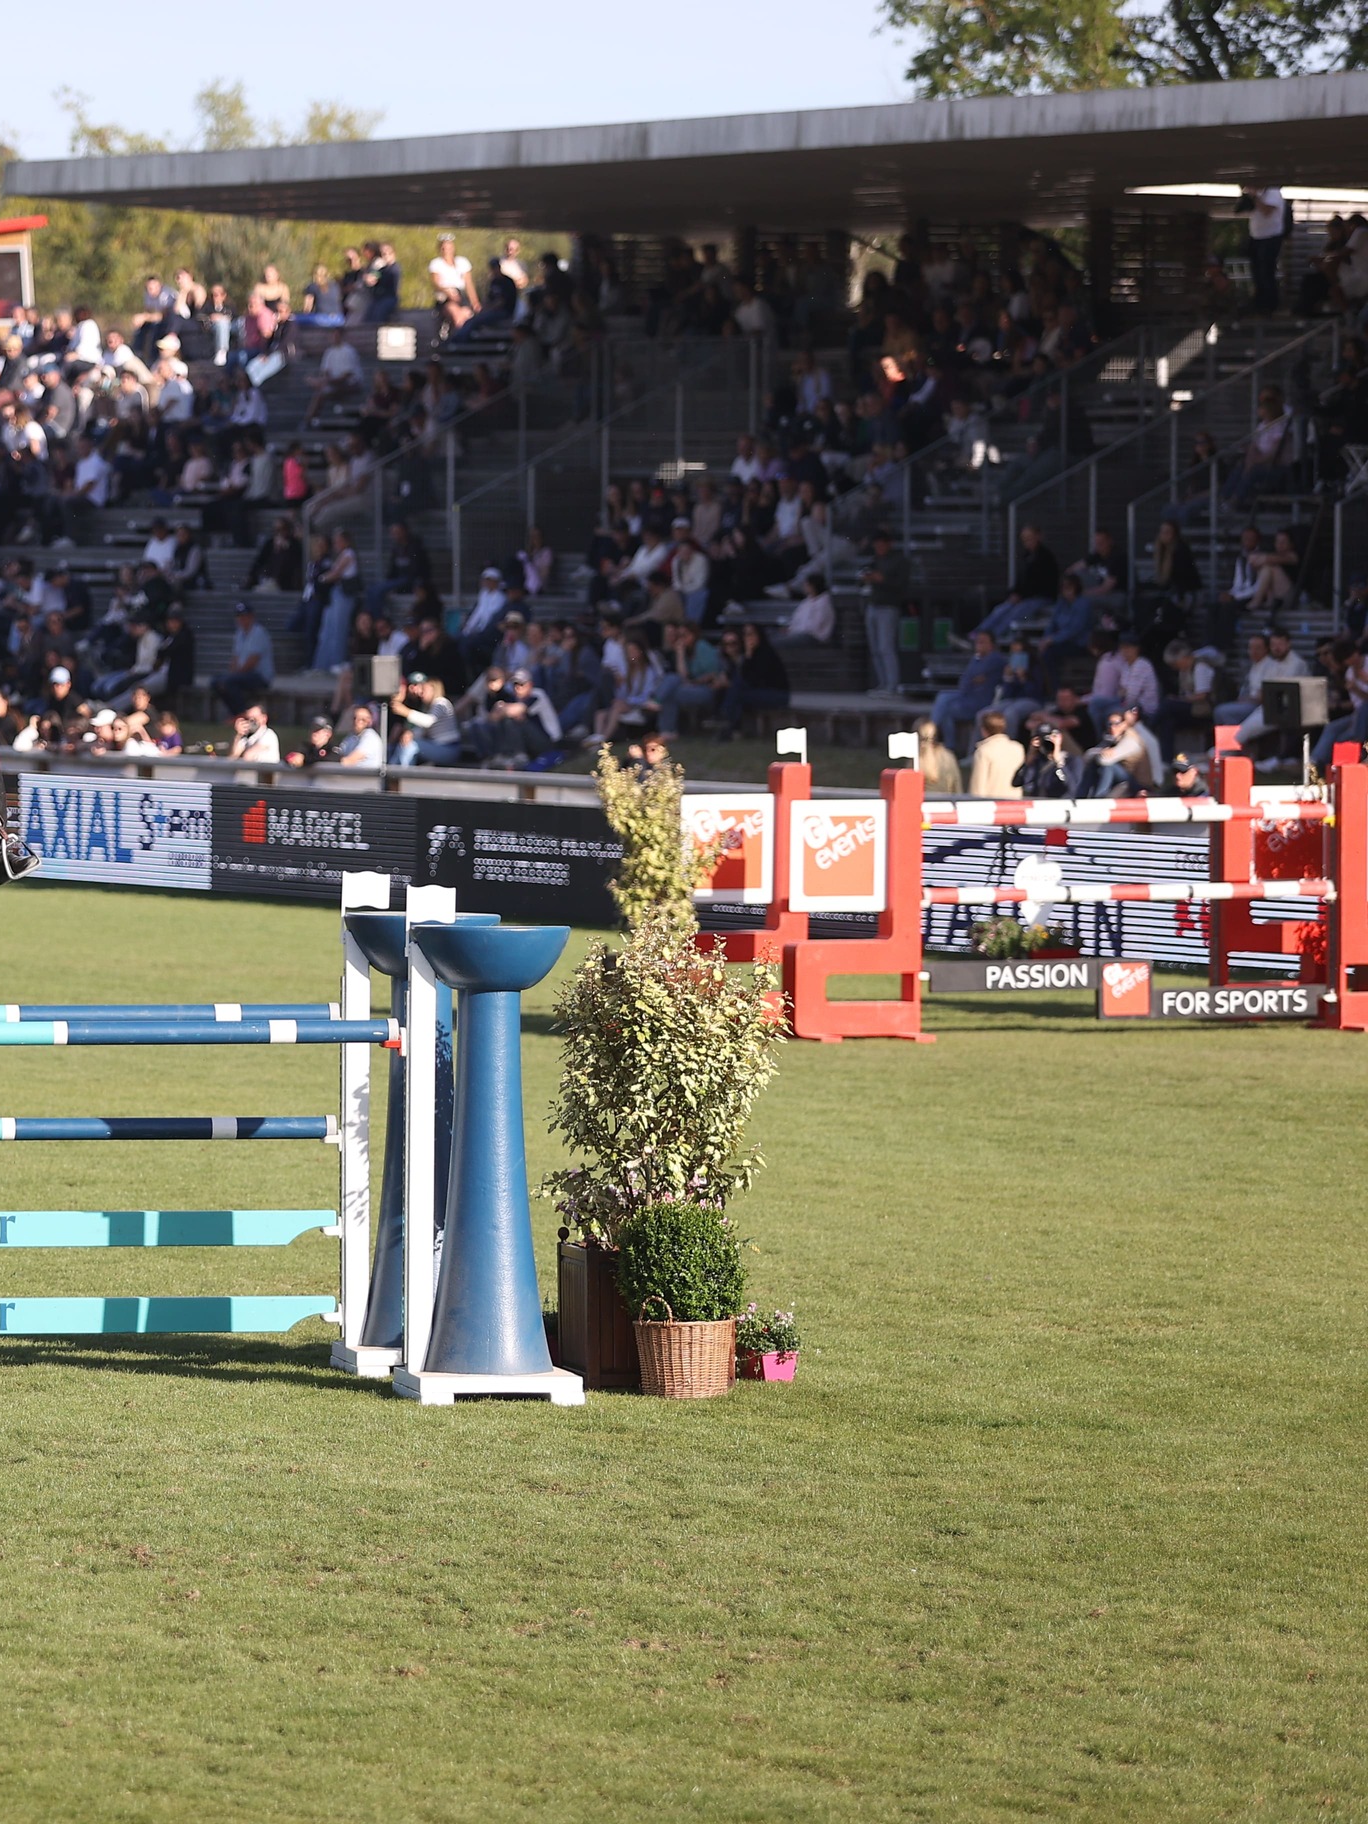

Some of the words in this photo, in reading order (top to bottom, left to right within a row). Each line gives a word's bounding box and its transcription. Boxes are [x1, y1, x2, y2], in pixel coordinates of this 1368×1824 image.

[24, 785, 133, 864] AXIAL
[268, 806, 370, 851] MARKEL
[803, 815, 848, 850] GL
[815, 817, 876, 870] events
[985, 963, 1089, 989] PASSION
[1102, 962, 1131, 986] GL
[1111, 965, 1149, 999] events
[1162, 990, 1211, 1016] FOR
[1213, 988, 1308, 1014] SPORTS
